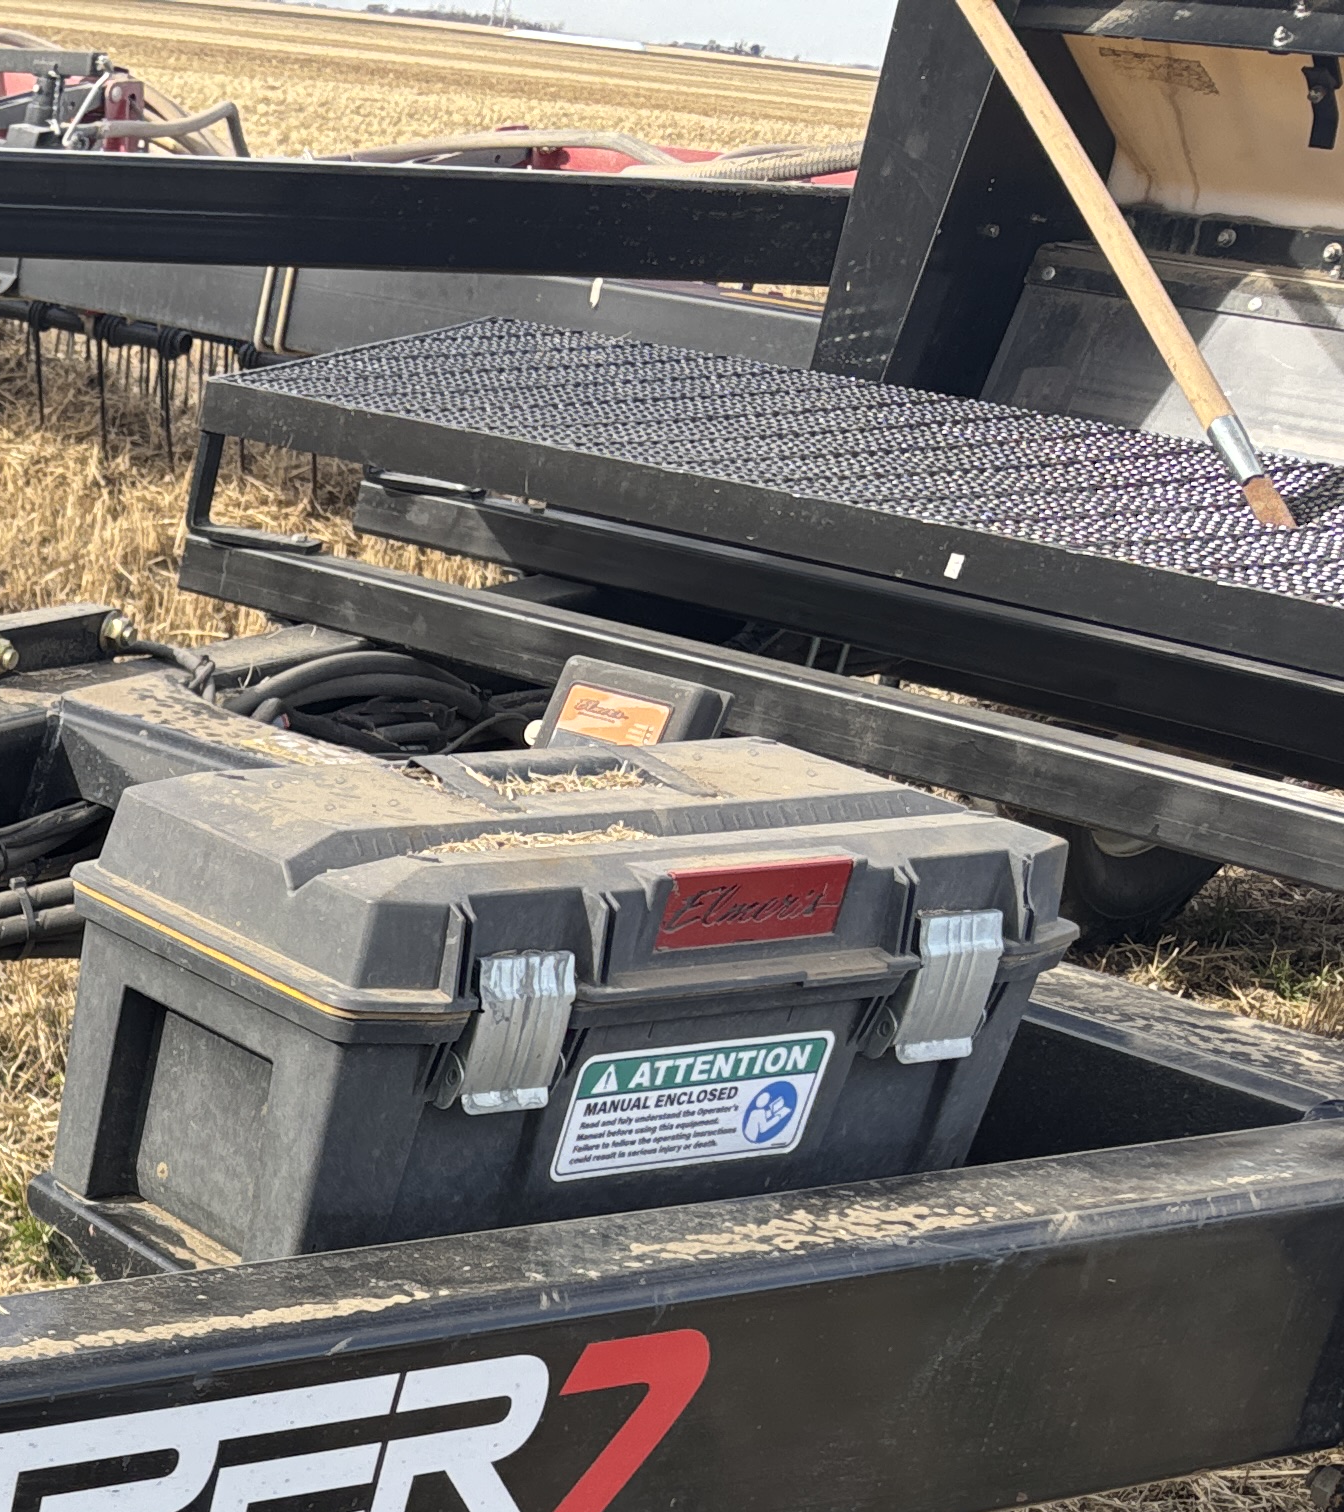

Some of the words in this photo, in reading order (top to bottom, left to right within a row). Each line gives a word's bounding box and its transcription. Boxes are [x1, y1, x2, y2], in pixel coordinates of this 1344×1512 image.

[663, 882, 840, 934] Elmer's
[627, 1044, 813, 1089] ATTENTION
[583, 1096, 650, 1117] MANUAL
[654, 1086, 739, 1108] ENCLOSED
[579, 1119, 600, 1130] Read
[600, 1117, 617, 1127] and
[634, 1109, 683, 1123] understand
[682, 1109, 696, 1117] the
[697, 1103, 739, 1116] Operator's
[573, 1143, 600, 1153] Failure
[601, 1141, 610, 1149] to
[611, 1138, 637, 1148] follow
[637, 1136, 652, 1145] the
[653, 1131, 691, 1144] operating
[576, 1129, 606, 1141] Manual
[606, 1128, 633, 1138] before
[634, 1125, 657, 1135] using
[658, 1121, 674, 1131] this
[569, 1154, 592, 1165] could
[593, 1151, 617, 1162] result
[617, 1149, 626, 1158] in
[627, 1147, 658, 1158] serious
[658, 1144, 682, 1154] injury
